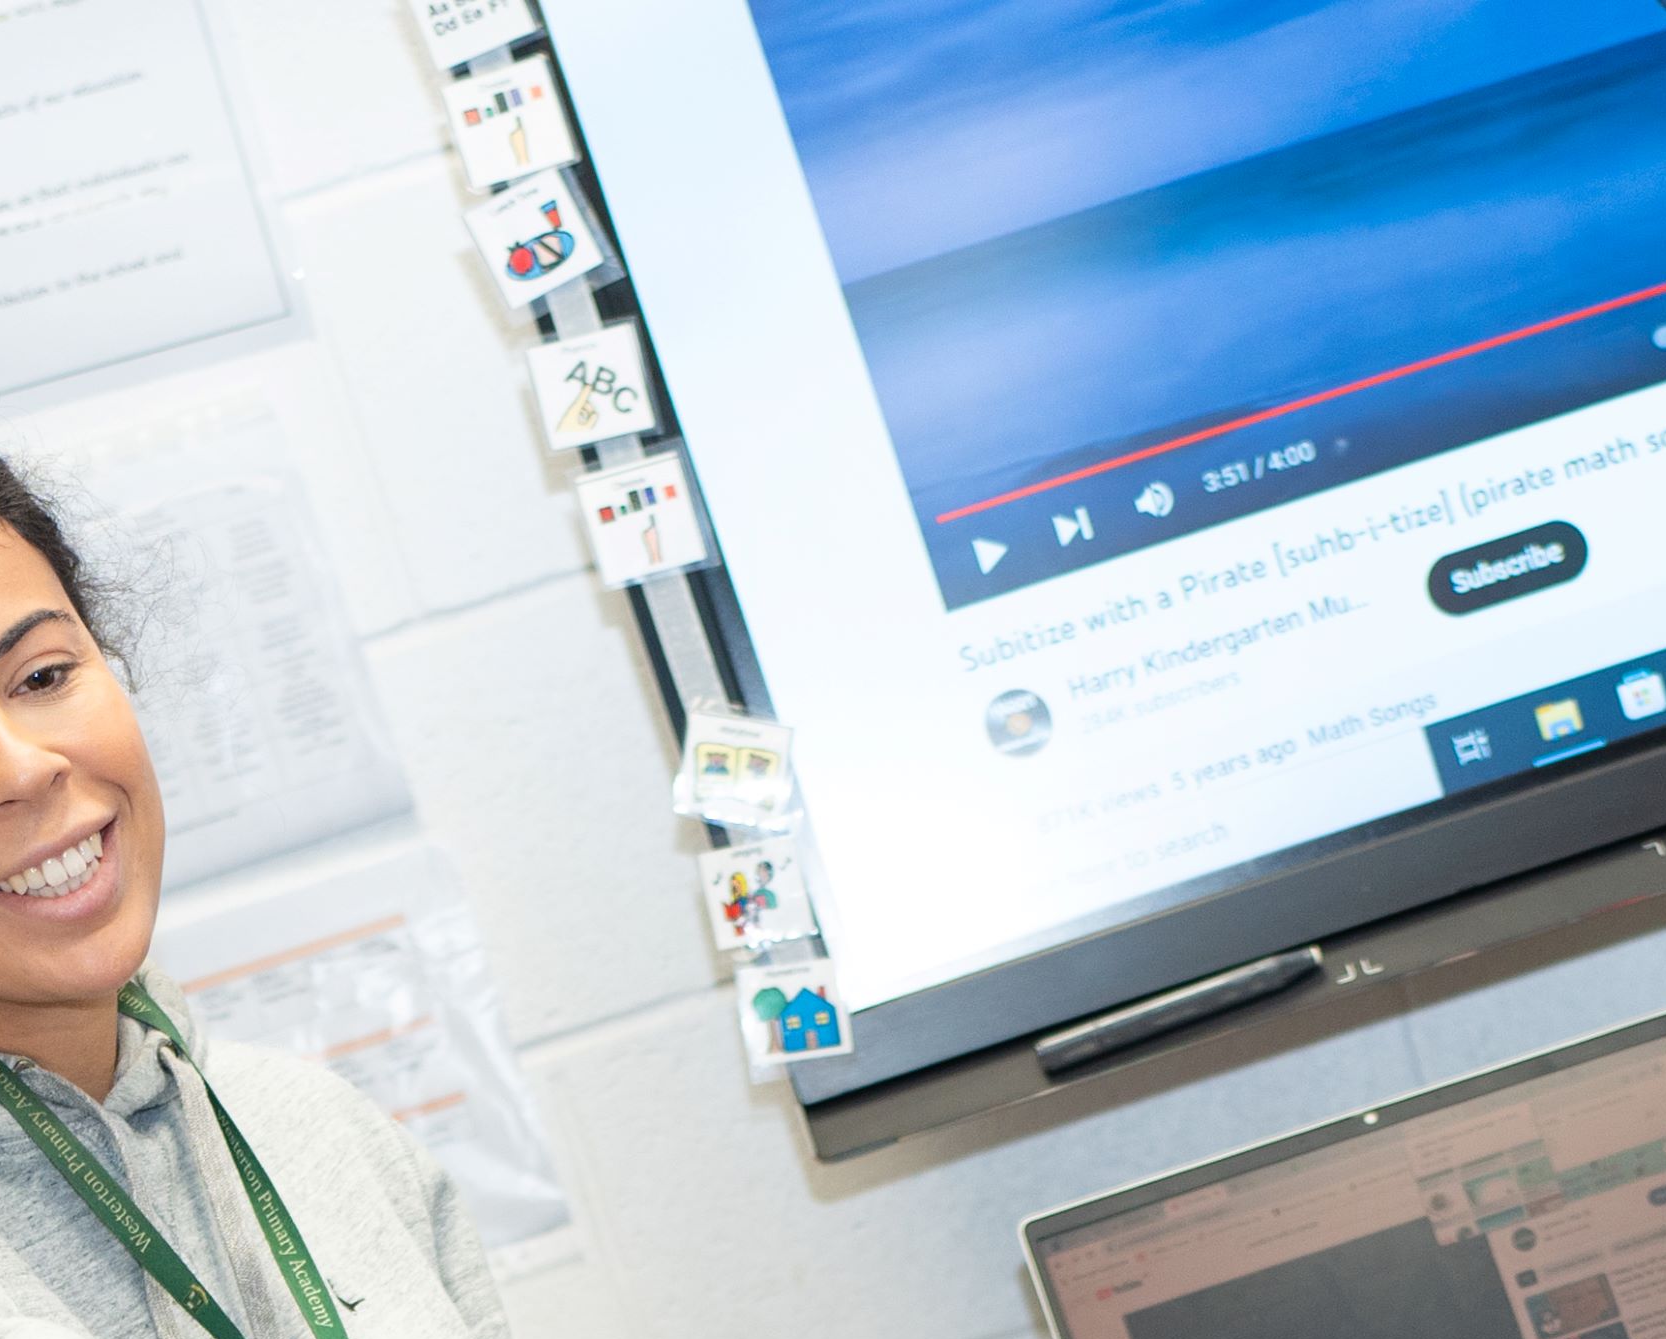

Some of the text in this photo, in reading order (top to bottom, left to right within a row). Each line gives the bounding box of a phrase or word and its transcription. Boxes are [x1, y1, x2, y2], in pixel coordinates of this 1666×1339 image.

[1199, 459, 1252, 496] 3:51
[1264, 438, 1320, 475] 4:00
[956, 613, 1079, 676] Subitize
[1086, 591, 1149, 634] with
[1153, 589, 1172, 611] a
[1178, 552, 1269, 603] Pirate
[1271, 489, 1457, 578] [suhb-i-tize]
[1458, 461, 1558, 517] (pirate
[1561, 436, 1638, 480] math
[1447, 536, 1567, 596] Subscribe
[1066, 659, 1139, 705] Harry
[1140, 606, 1307, 680] Kindergarten
[1191, 751, 1253, 792] years
[1254, 738, 1300, 771] ago
[1304, 713, 1366, 749] Math
[1367, 691, 1440, 735] Songs
[27, 1105, 83, 1178] Primary
[83, 1169, 152, 1253] Westerton
[255, 1186, 299, 1257] Primary
[288, 1257, 334, 1330] Academy
